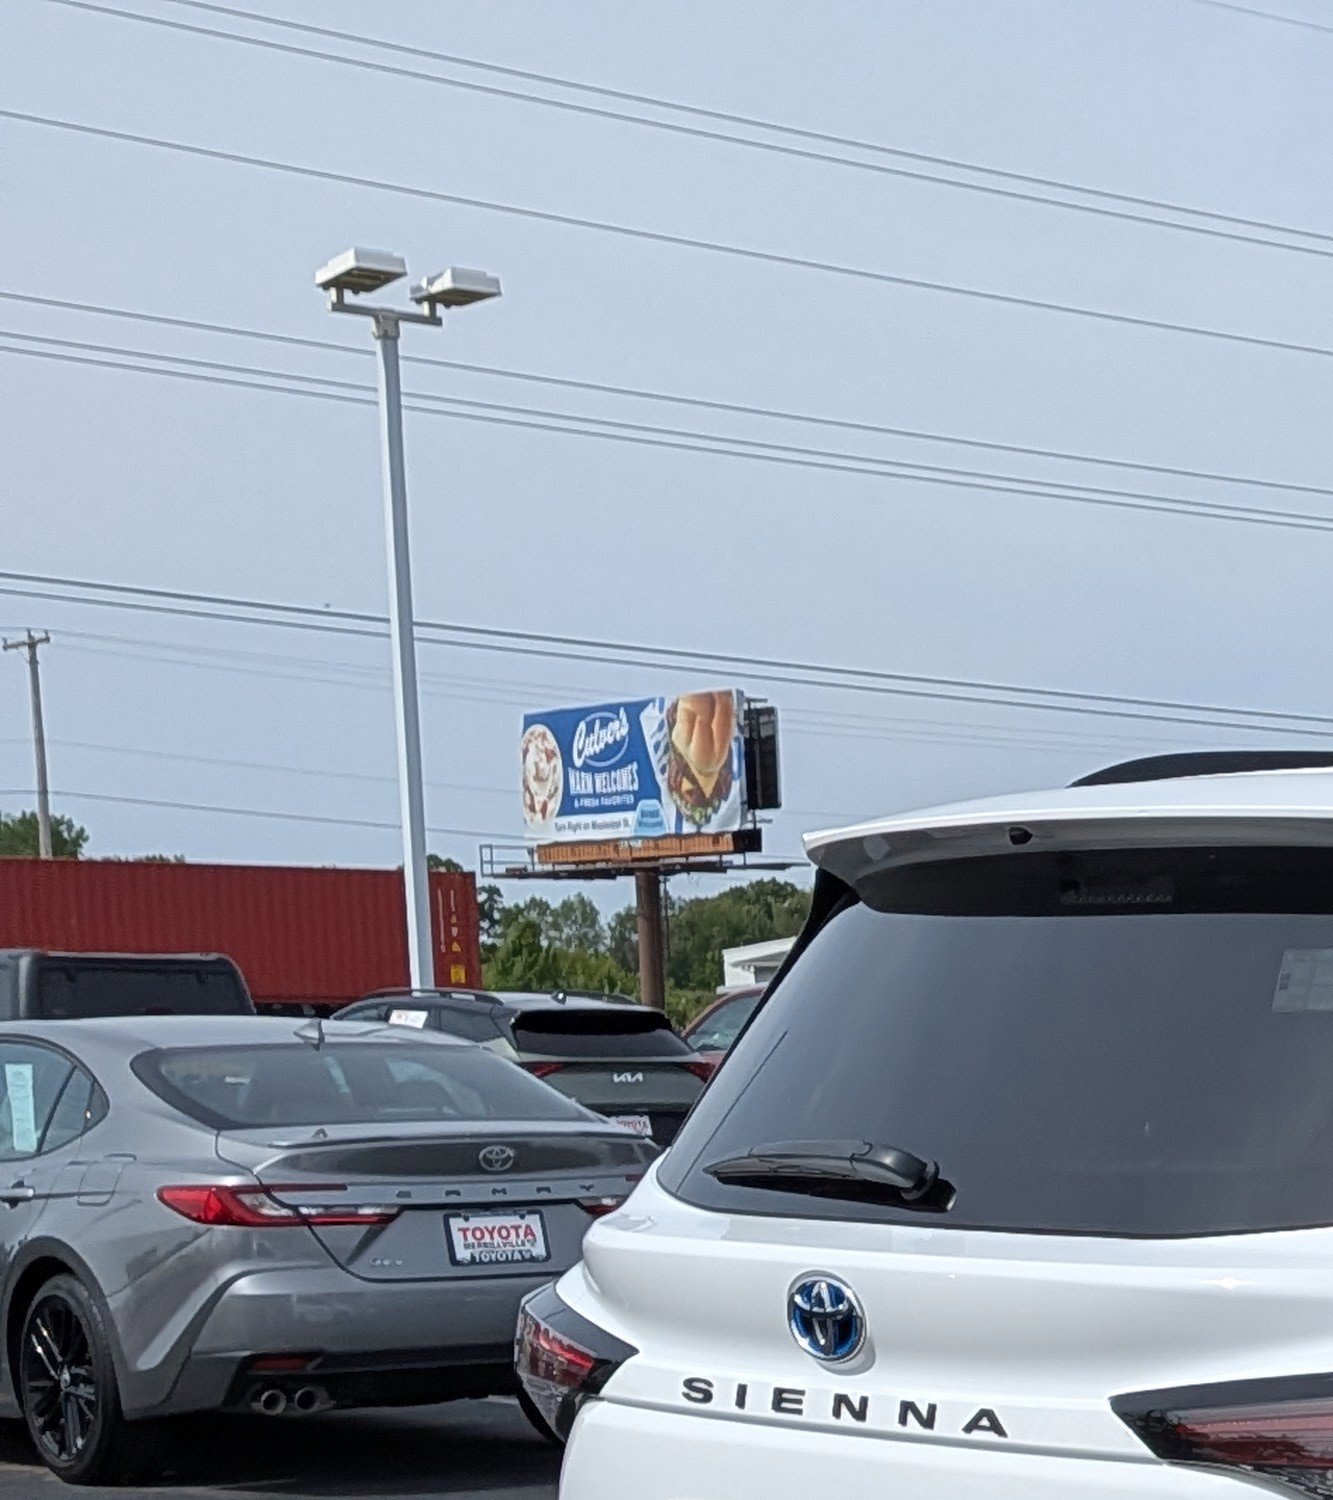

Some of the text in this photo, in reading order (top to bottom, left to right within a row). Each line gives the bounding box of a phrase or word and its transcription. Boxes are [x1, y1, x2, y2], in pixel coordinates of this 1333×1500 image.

[594, 761, 639, 794] WELCOMES
[613, 1072, 643, 1083] KIA
[396, 1184, 594, 1199] CAMRY
[458, 1224, 537, 1243] TOYOTA
[473, 1250, 522, 1262] TOYOTA
[682, 1377, 1008, 1438] SIENNA
